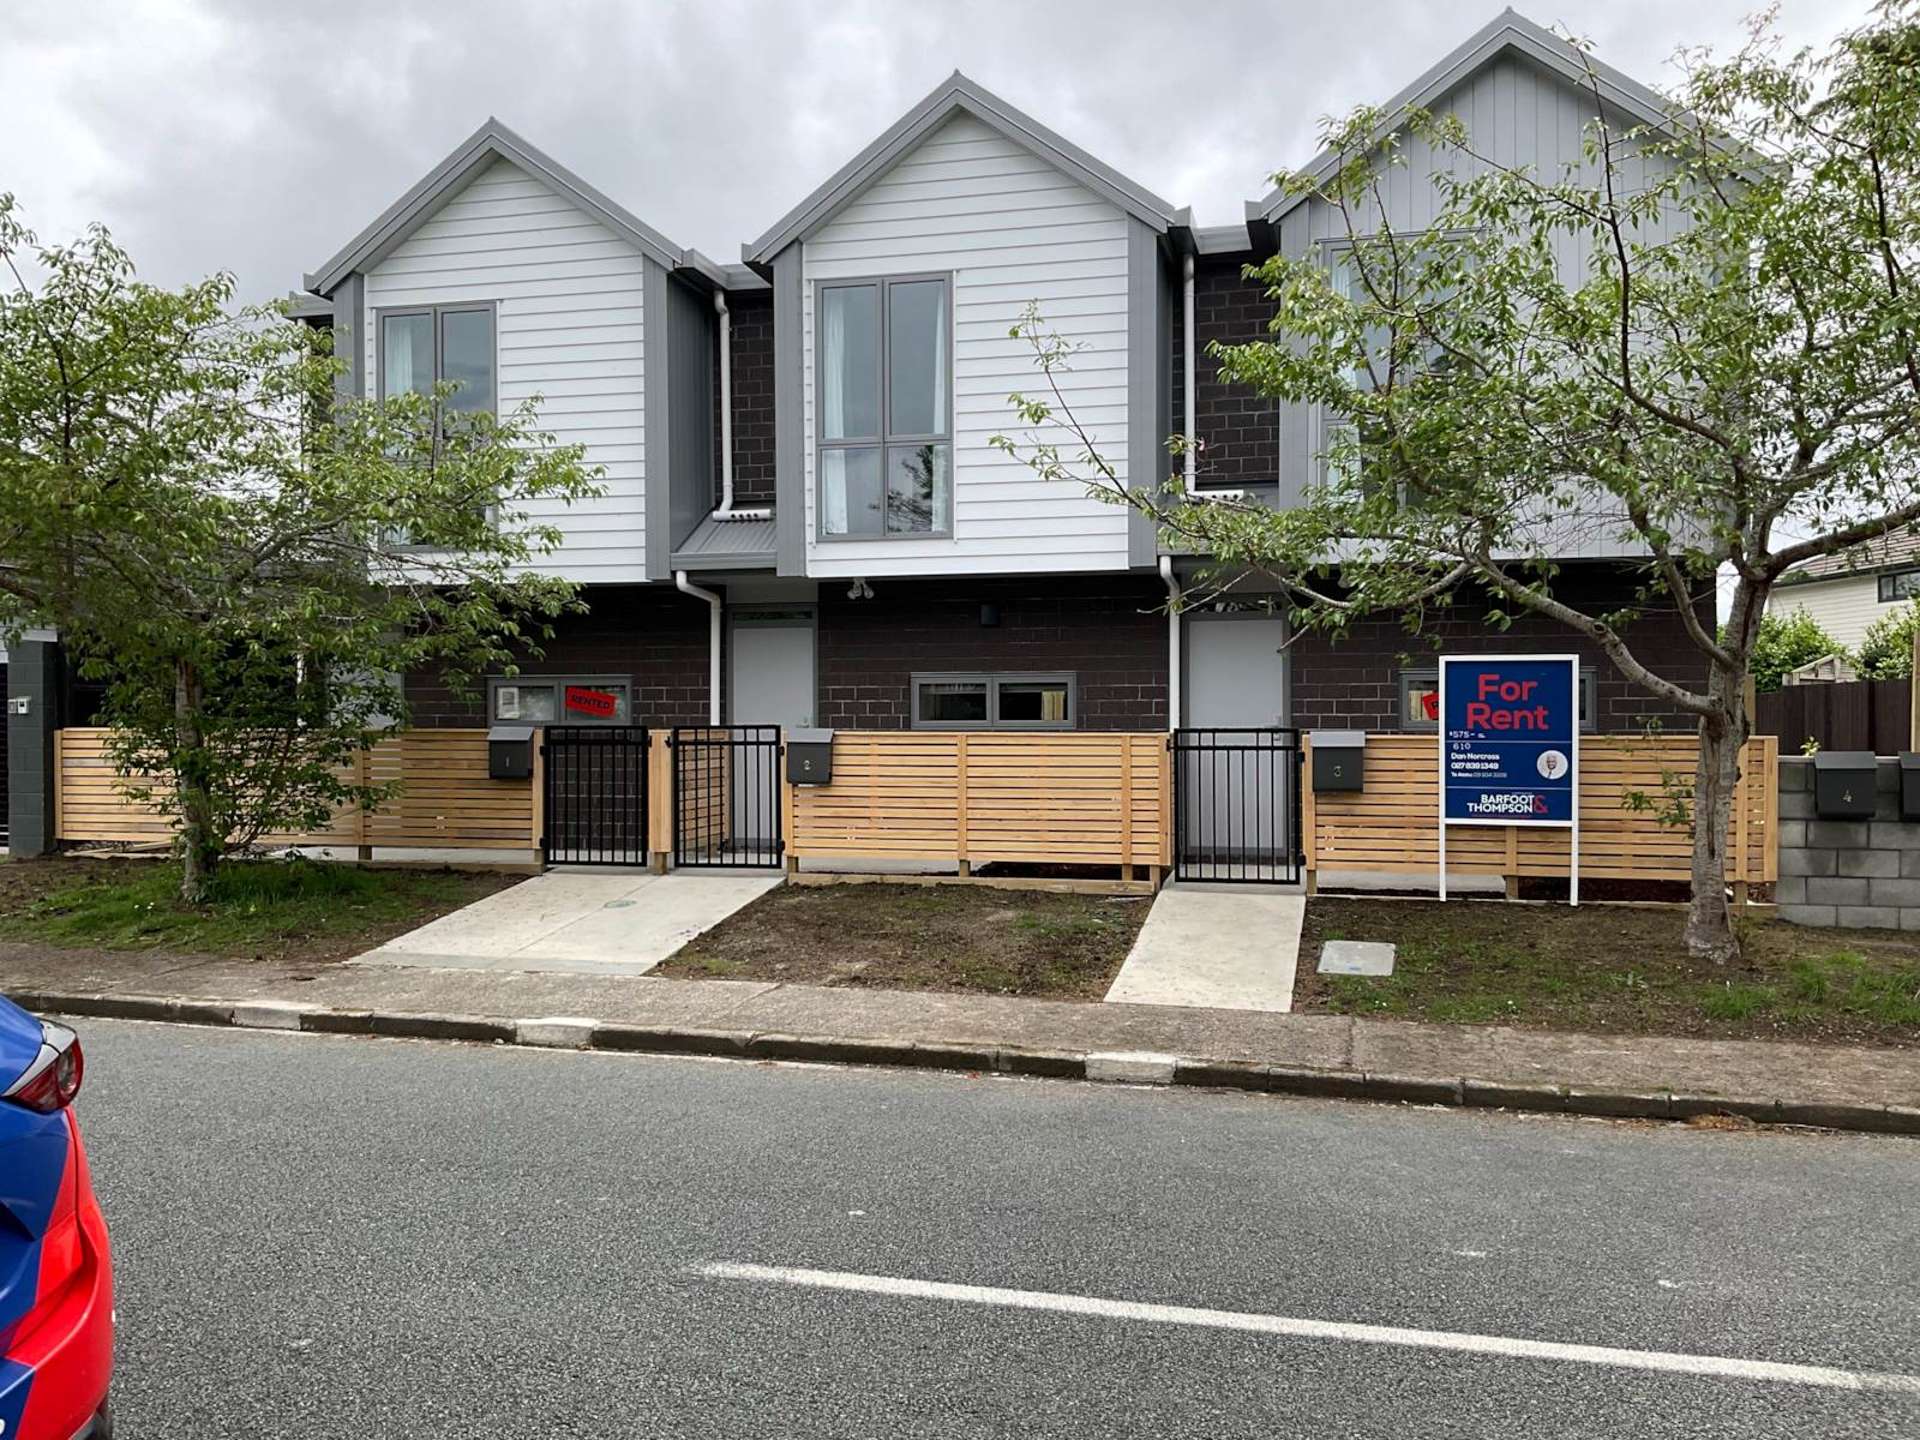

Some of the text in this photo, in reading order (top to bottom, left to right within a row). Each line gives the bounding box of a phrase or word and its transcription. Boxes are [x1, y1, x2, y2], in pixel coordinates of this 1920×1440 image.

[1478, 673, 1538, 702] For
[1466, 702, 1549, 731] Rent
[803, 759, 811, 771] 2
[1333, 765, 1342, 777] 3
[1481, 794, 1535, 804] BARFOOT
[1842, 789, 1852, 803] 4
[1466, 802, 1534, 813] THOMPSON
